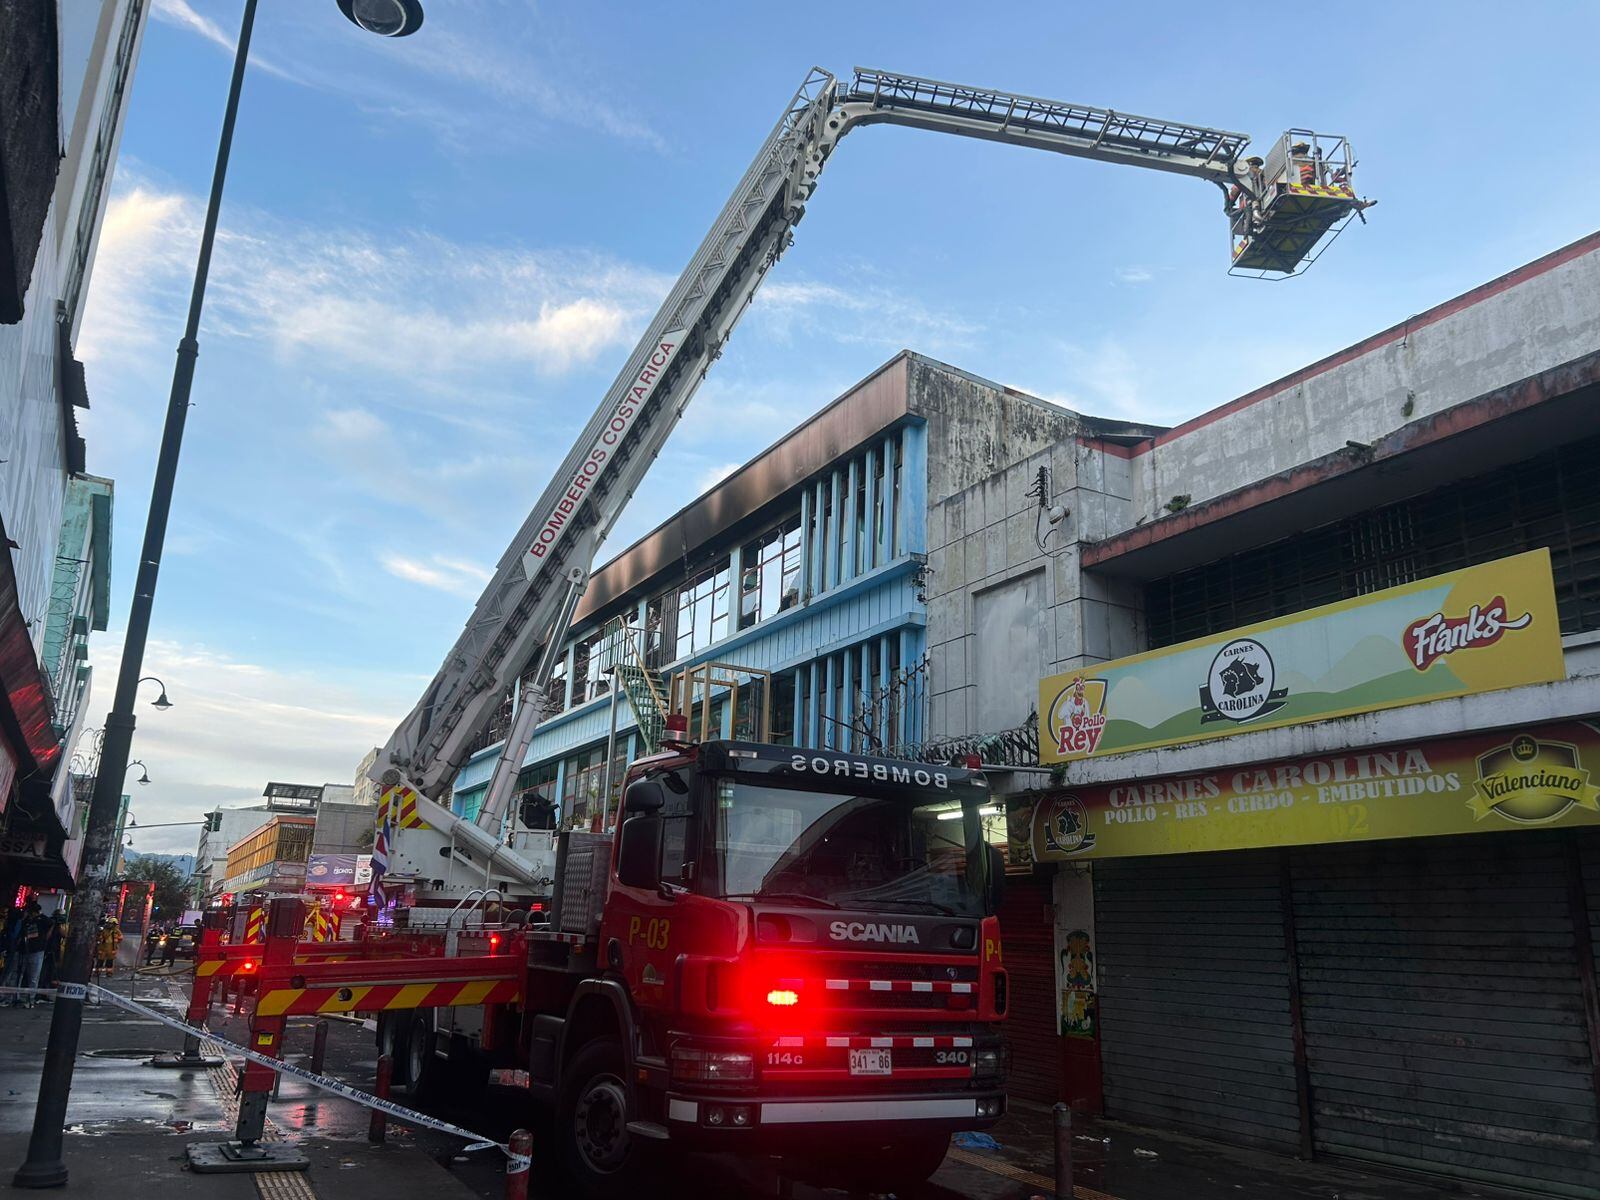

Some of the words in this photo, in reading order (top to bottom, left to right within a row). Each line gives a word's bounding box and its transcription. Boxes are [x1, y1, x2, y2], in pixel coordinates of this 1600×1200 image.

[530, 448, 607, 558] BOMBEROS
[602, 386, 648, 446] COSTA
[639, 341, 675, 385] RICA
[1412, 604, 1532, 667] Franks
[1223, 644, 1254, 657] CARNES
[1218, 694, 1264, 711] CAROLINA
[1083, 715, 1105, 728] Pollo
[1058, 726, 1102, 753] Rey
[1109, 776, 1220, 808] CARNES
[1231, 749, 1432, 795] CAROLINA
[1481, 769, 1582, 800] Valenciano
[1104, 806, 1157, 825] POLLO
[1175, 801, 1208, 819] RES
[1227, 791, 1295, 813] CERDO
[1317, 772, 1461, 804] EMBUTIDOS
[628, 916, 670, 950] P-03
[829, 921, 919, 944] SCANIA
[936, 1051, 968, 1064] 340
